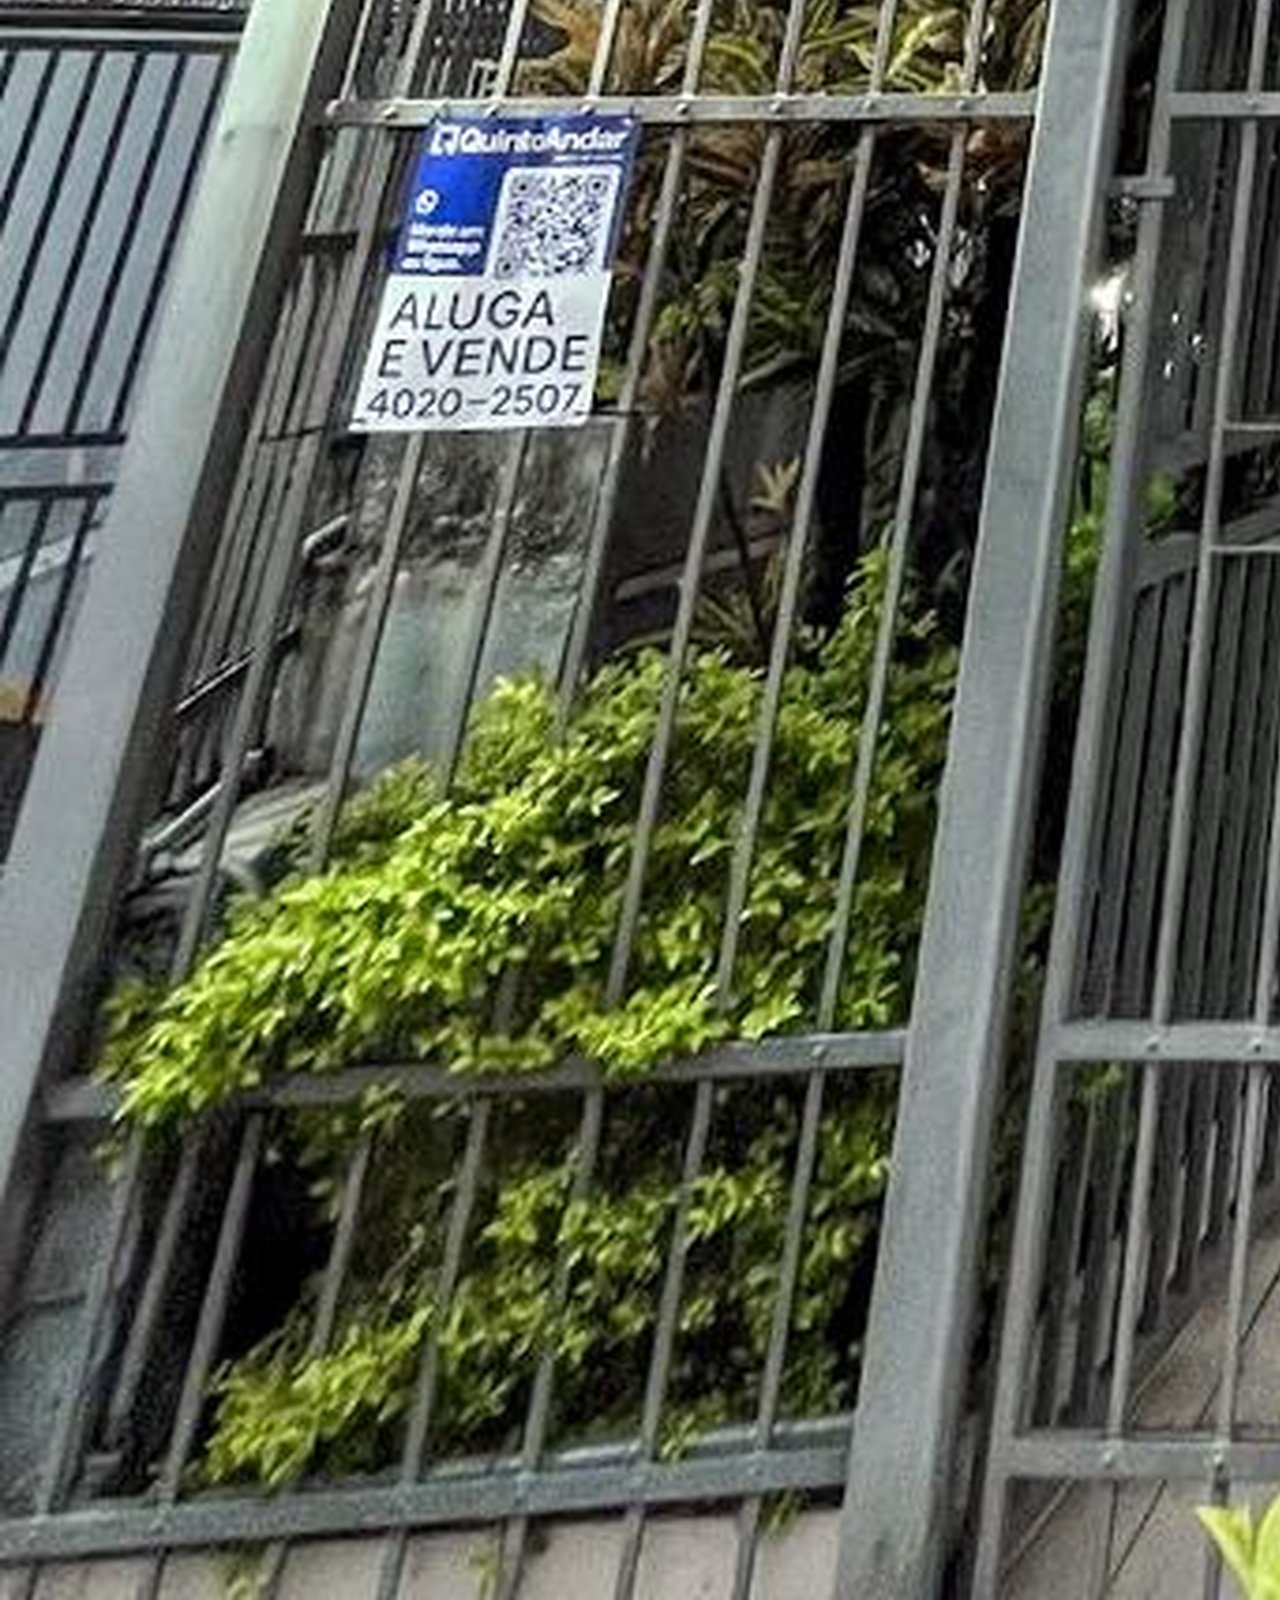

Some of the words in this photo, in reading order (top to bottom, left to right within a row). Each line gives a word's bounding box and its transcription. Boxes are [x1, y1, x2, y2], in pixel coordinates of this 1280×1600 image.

[460, 126, 629, 153] QuintoAndar
[388, 289, 554, 331] ALUGA
[377, 339, 407, 379] E
[421, 335, 590, 378] VENDE
[366, 384, 583, 420] 4020-2507
